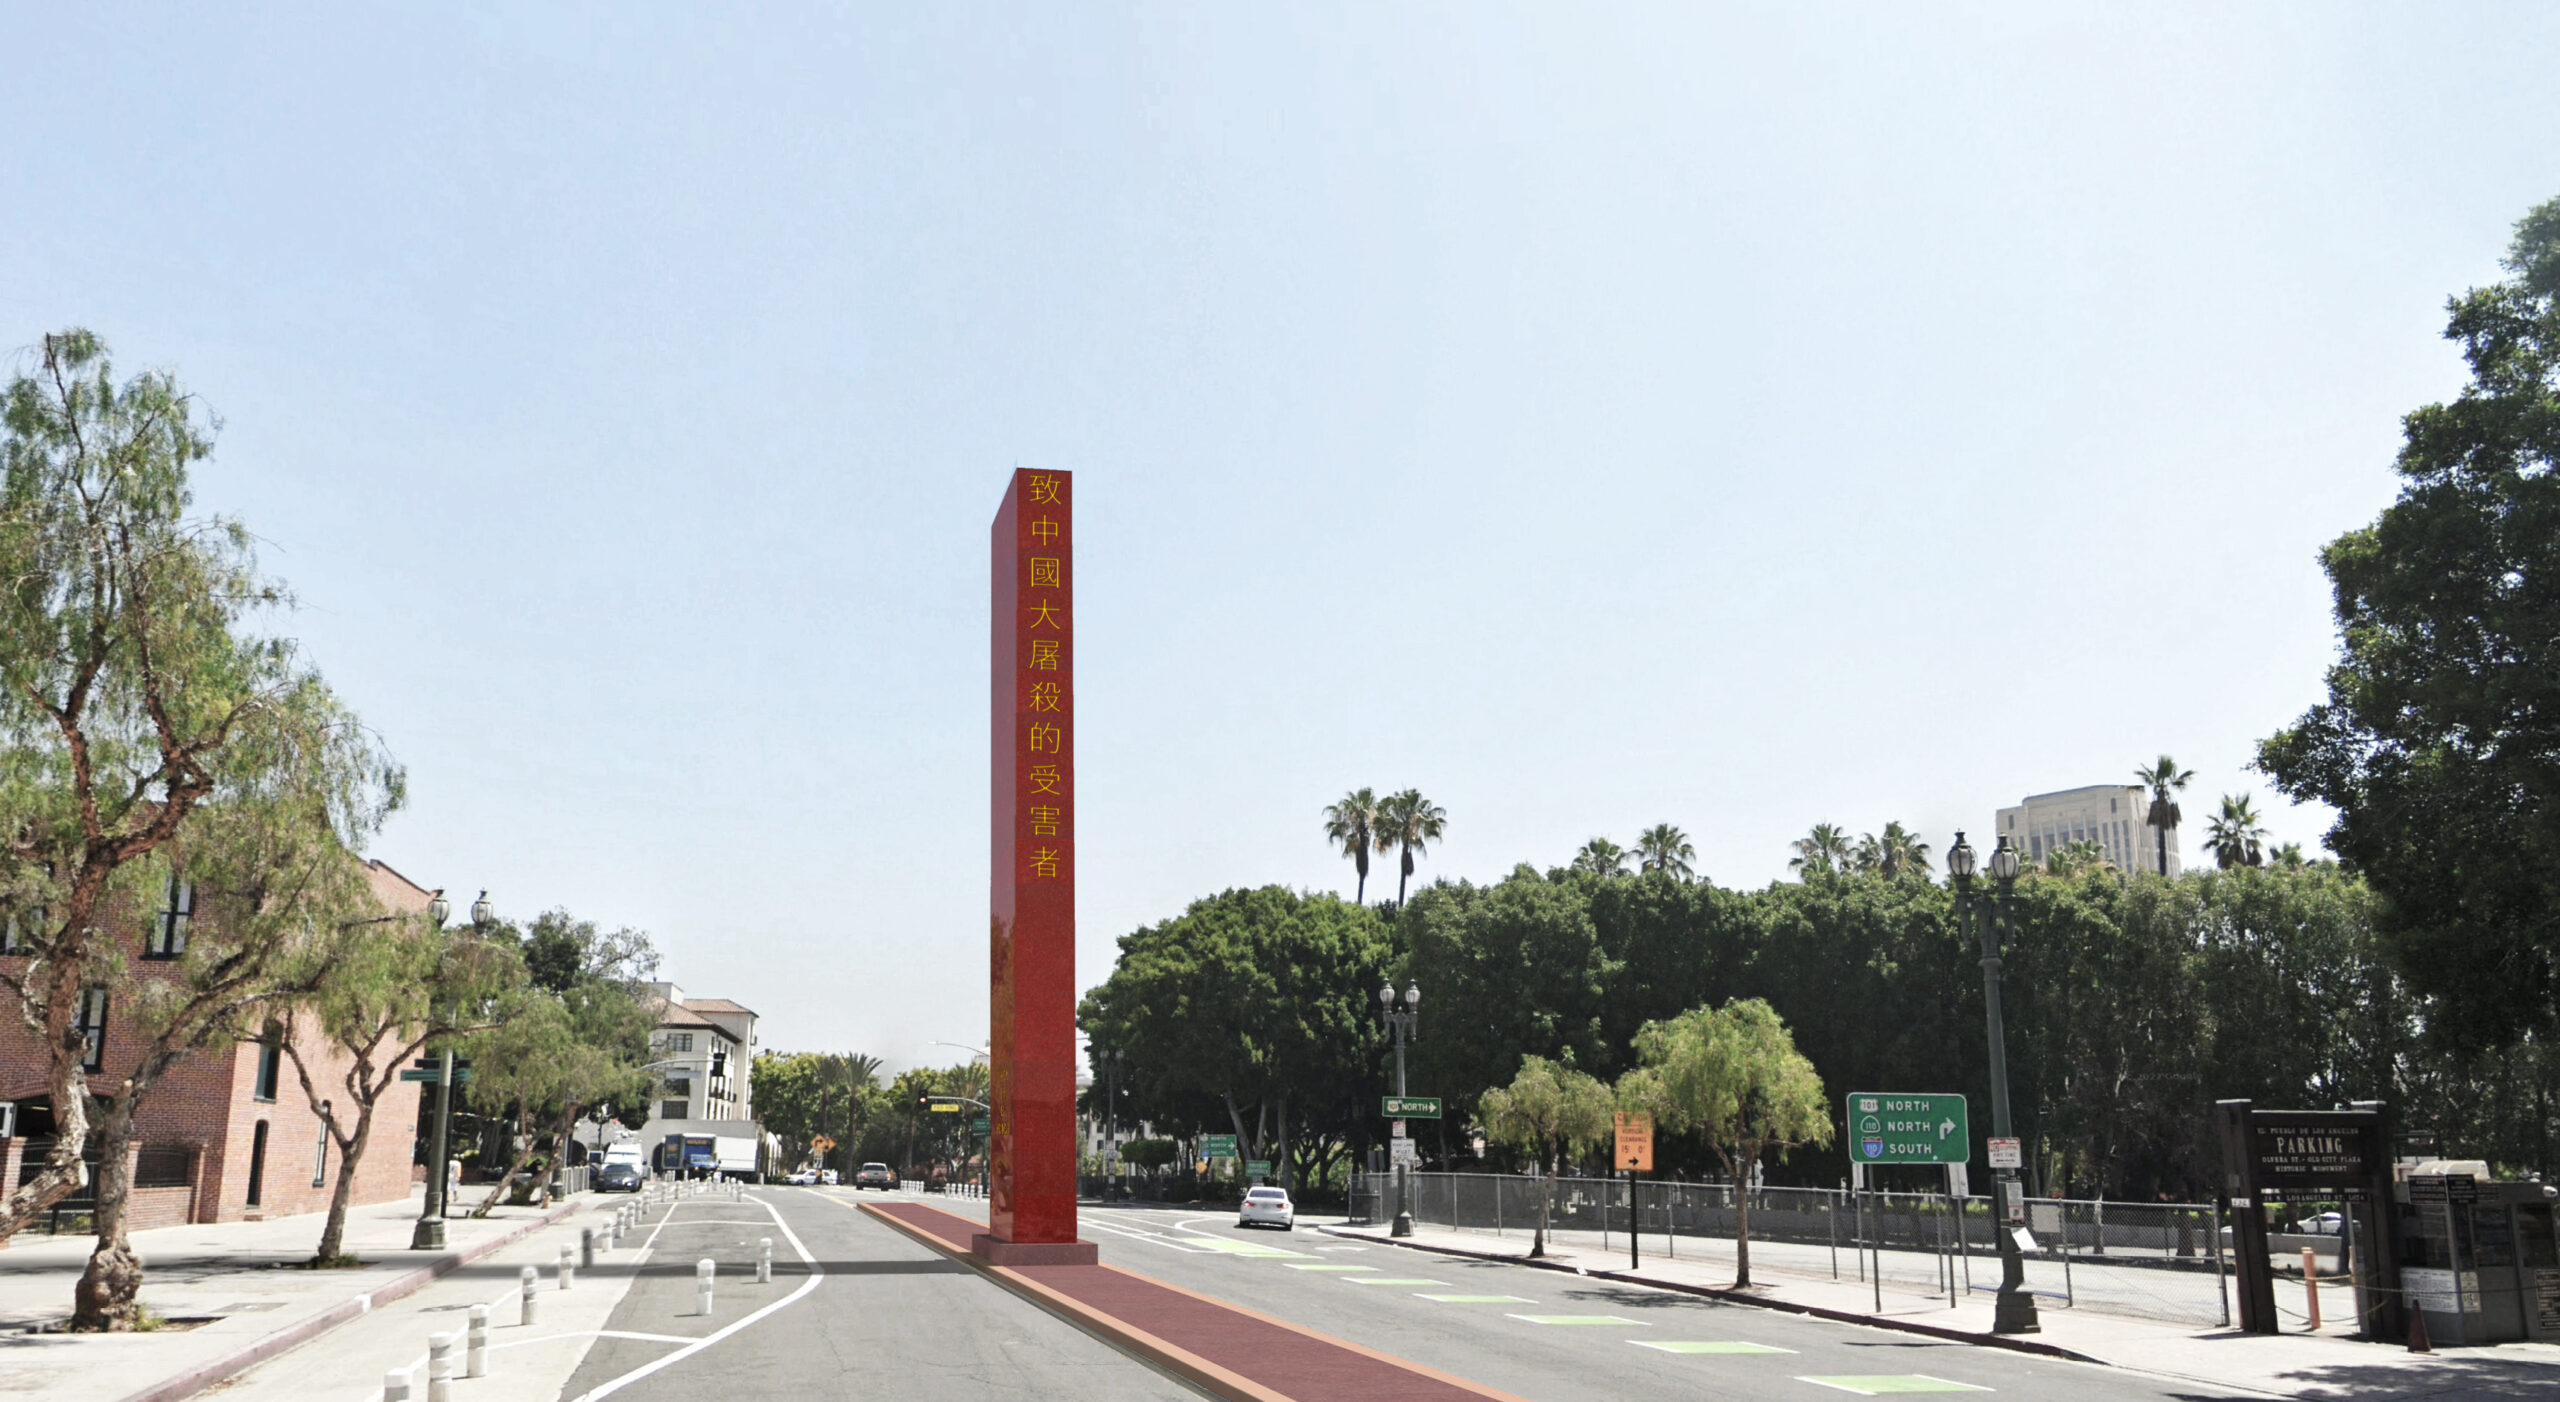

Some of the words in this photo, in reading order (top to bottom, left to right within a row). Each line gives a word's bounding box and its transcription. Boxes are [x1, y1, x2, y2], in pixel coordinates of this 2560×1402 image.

[1029, 473, 1062, 878] 致中國大屠殺的受害者
[1401, 1103, 1428, 1111] NORTH
[1863, 1101, 1876, 1109] 101
[1886, 1100, 1930, 1112] NORTH
[1887, 1121, 1931, 1132] NORTH
[1889, 1143, 1932, 1154] SOUTH
[2276, 1136, 2343, 1154] PARKING
